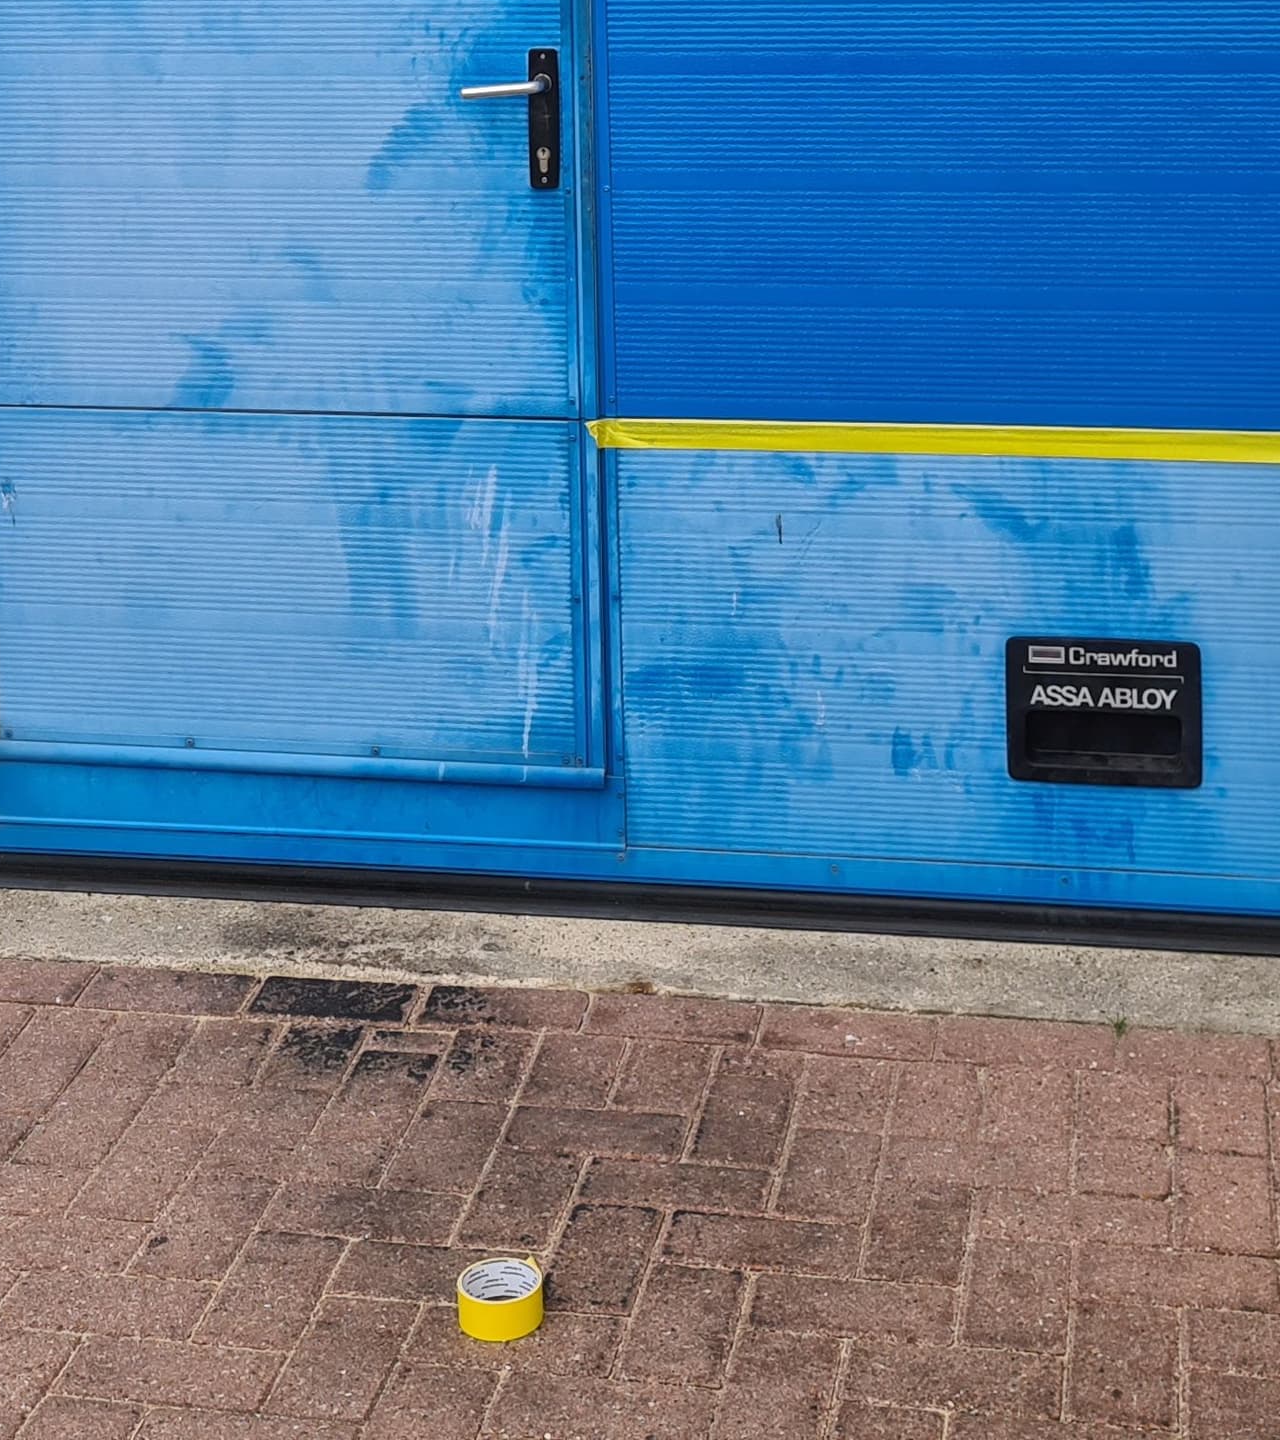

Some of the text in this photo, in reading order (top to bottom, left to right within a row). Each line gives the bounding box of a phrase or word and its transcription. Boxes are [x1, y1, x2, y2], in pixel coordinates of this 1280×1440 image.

[1069, 646, 1177, 668] Crawford
[1030, 684, 1178, 710] ASSA ABLOY
